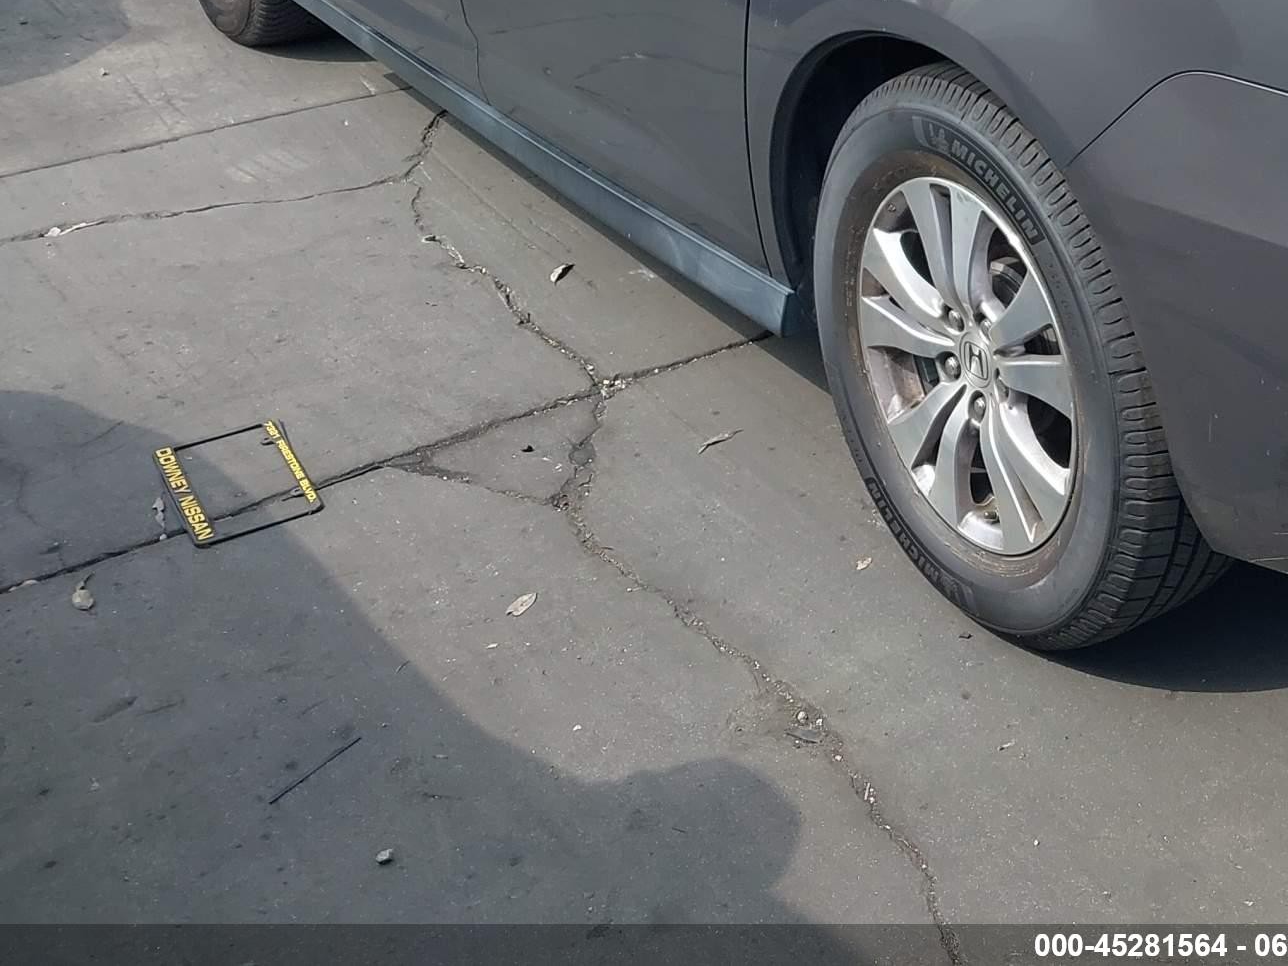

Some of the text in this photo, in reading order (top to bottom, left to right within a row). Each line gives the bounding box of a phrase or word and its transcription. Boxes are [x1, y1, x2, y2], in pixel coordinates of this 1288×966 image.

[951, 140, 1040, 240] MICHELIN
[156, 447, 214, 541] DOWNEY NISSAN
[276, 440, 304, 480] FIRESTONE
[868, 482, 940, 584] MICHELIN
